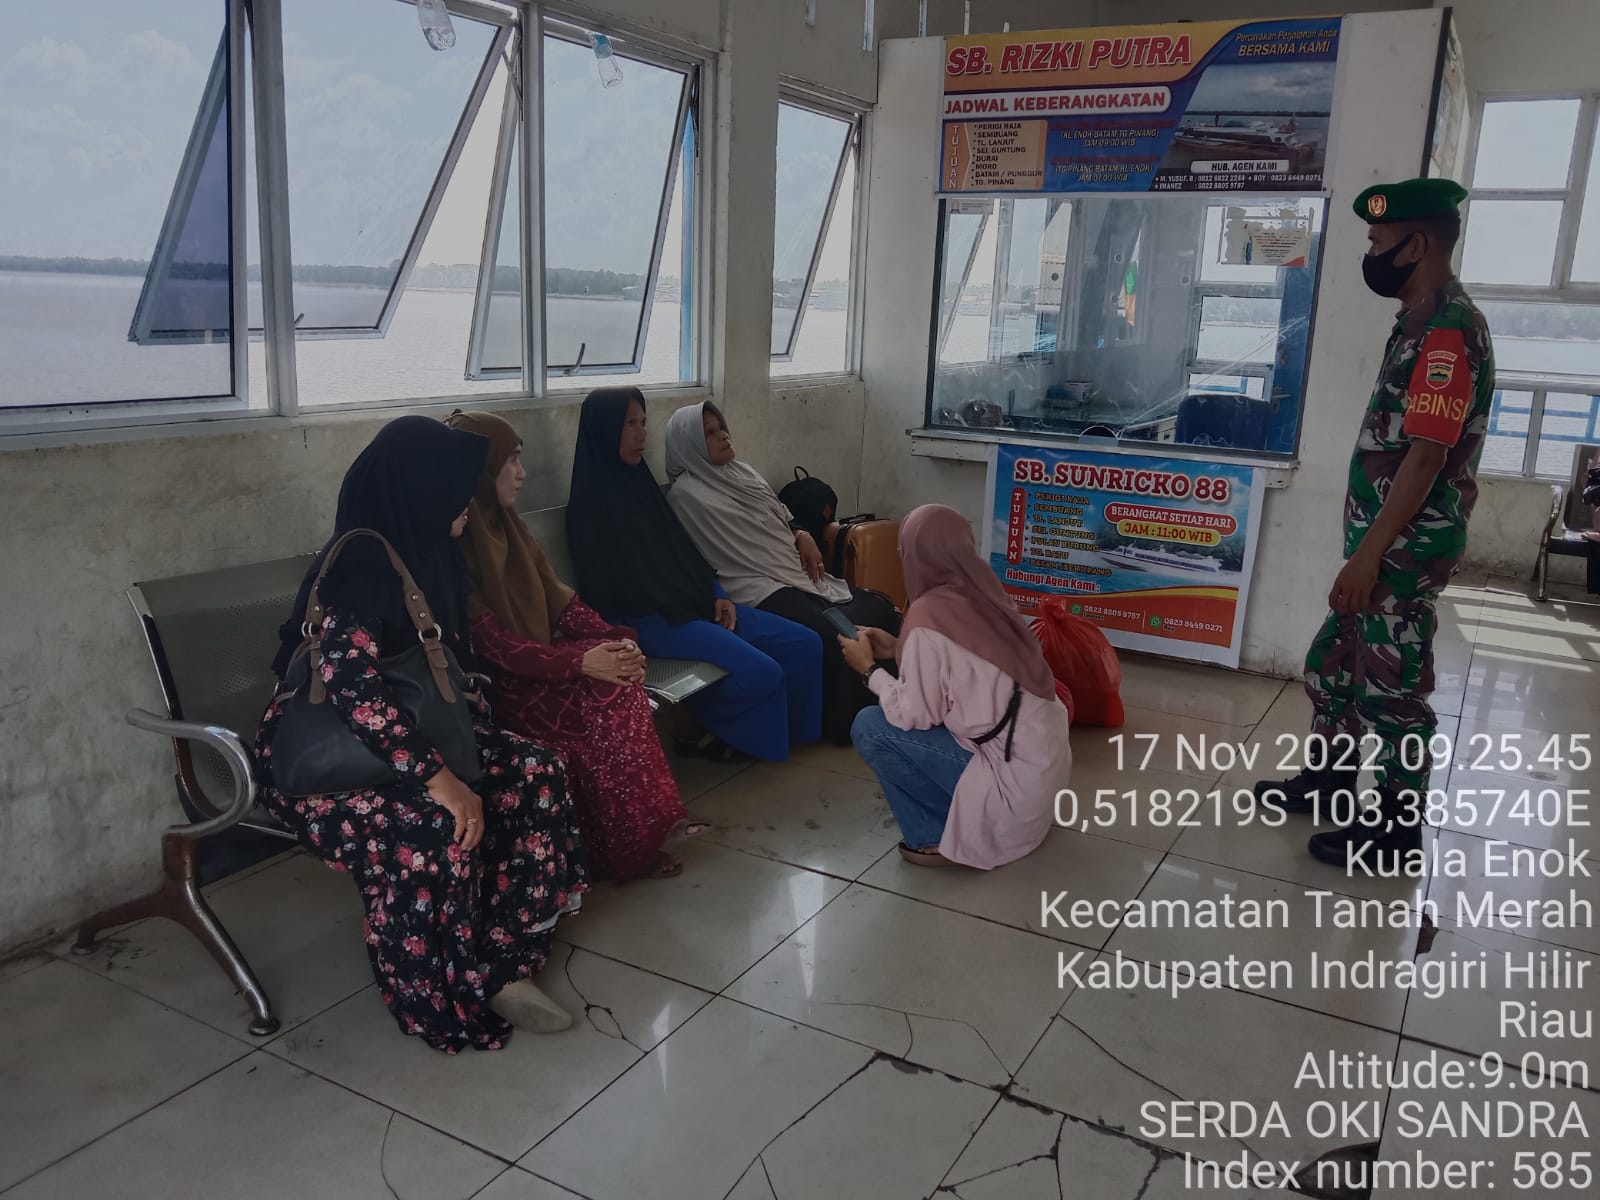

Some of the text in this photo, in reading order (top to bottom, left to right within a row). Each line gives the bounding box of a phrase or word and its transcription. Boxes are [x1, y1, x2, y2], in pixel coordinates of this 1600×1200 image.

[1318, 28, 1337, 38] Anda
[946, 34, 1192, 76] SB. RIZKI PUTRA
[1238, 40, 1330, 56] BERSAMA KAMI
[945, 91, 1166, 114] JADWAL KEBERANGKATAN
[1122, 138, 1136, 146] WIB
[1211, 162, 1278, 171] HUB. AGEN KAMI
[1408, 393, 1469, 422] ABINS
[1014, 460, 1230, 501] SB. SUNRICKO 88
[1111, 505, 1232, 528] BERANGKAT SETIAP HARI
[1124, 522, 1150, 536] JAM
[1157, 525, 1186, 539] 11:00
[1188, 528, 1213, 543] WIB
[1006, 568, 1044, 584] Hubungi
[1045, 576, 1069, 588] Agen
[1070, 578, 1096, 592] Kami
[1204, 624, 1224, 632] 0271
